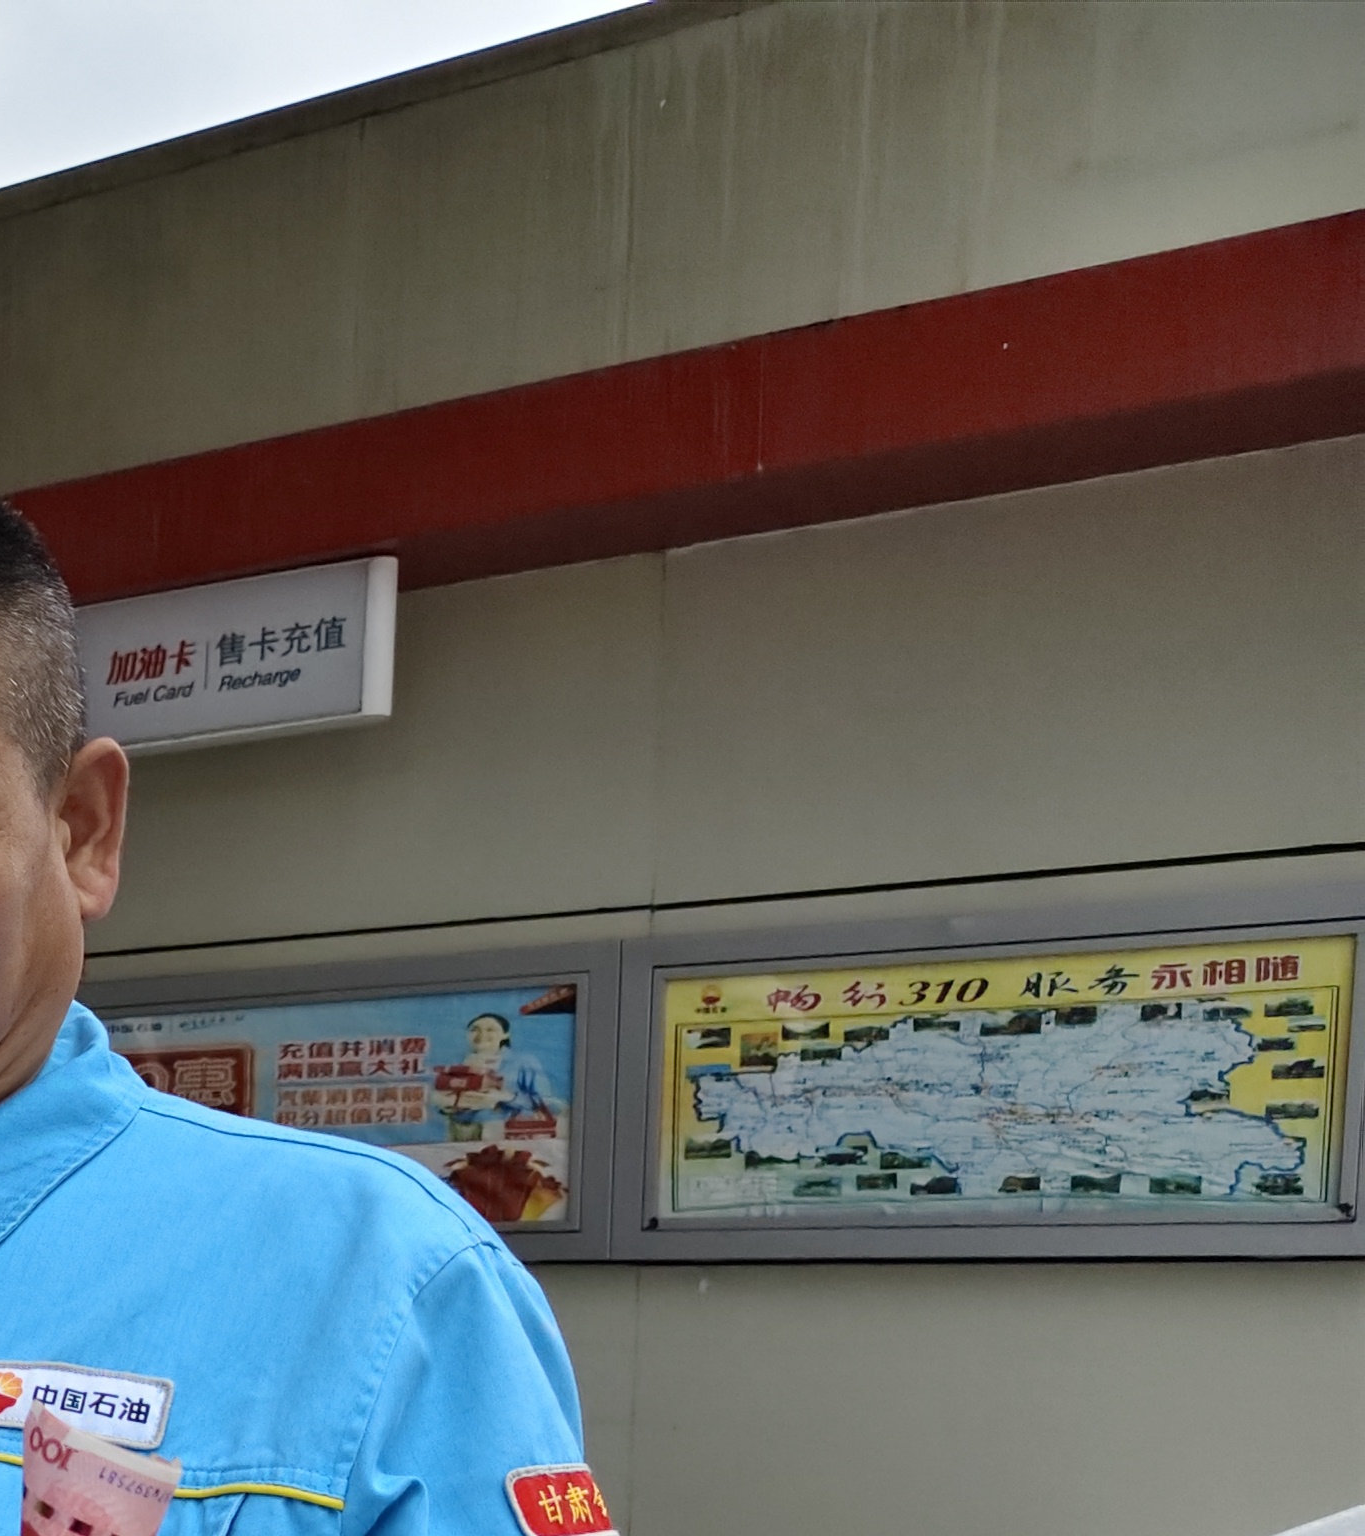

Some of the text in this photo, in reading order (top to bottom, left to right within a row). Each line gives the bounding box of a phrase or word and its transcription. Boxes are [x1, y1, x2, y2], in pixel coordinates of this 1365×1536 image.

[106, 639, 197, 686] 加油卡
[215, 615, 348, 668] 售卡充值
[113, 680, 195, 709] Fuel Card
[217, 665, 301, 693] Recharge
[278, 1037, 426, 1061] 充值并消费
[32, 1383, 152, 1425] 中国石油
[28, 1425, 79, 1473] 100
